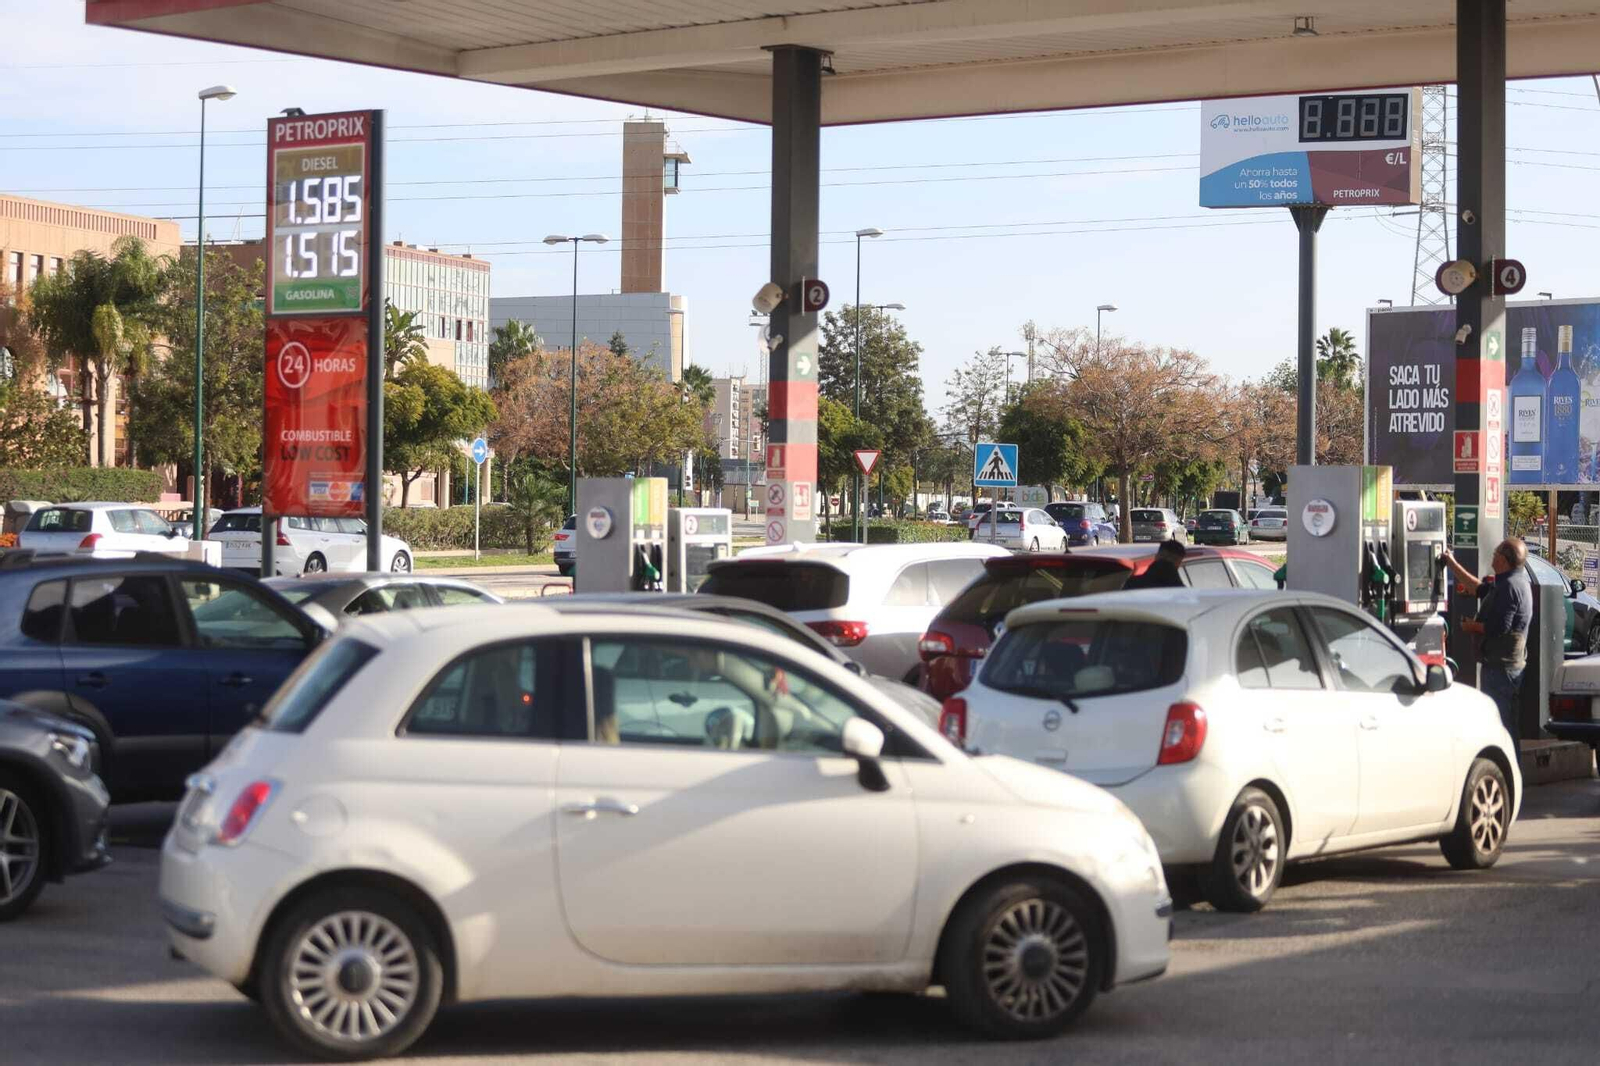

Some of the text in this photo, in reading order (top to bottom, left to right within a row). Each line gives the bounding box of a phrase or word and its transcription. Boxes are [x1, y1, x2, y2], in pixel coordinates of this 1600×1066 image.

[275, 116, 364, 142] PETROPRIX
[301, 157, 338, 171] DIESEL
[1385, 152, 1406, 165] €/L
[1240, 167, 1297, 176] Ahorra hasta
[1249, 180, 1268, 188] 50%
[1270, 179, 1297, 188] todos
[289, 175, 361, 224] 1.585
[1260, 190, 1297, 200] los años
[1333, 189, 1380, 198] PETROPRIX
[285, 231, 358, 278] 1.515
[1505, 269, 1516, 285] 4
[285, 290, 334, 300] GASOLINA
[812, 289, 822, 303] 2
[284, 355, 356, 374] 24 HORAS
[1389, 364, 1440, 386] SACA TU
[1389, 383, 1449, 409] LADO MÁS
[1586, 399, 1600, 407] RIVE
[1389, 413, 1445, 433] ATREVIDO
[281, 430, 352, 442] COMBUSTIBLE
[281, 445, 350, 461] LOW COST
[689, 518, 695, 530] 2
[1409, 512, 1415, 528] 4
